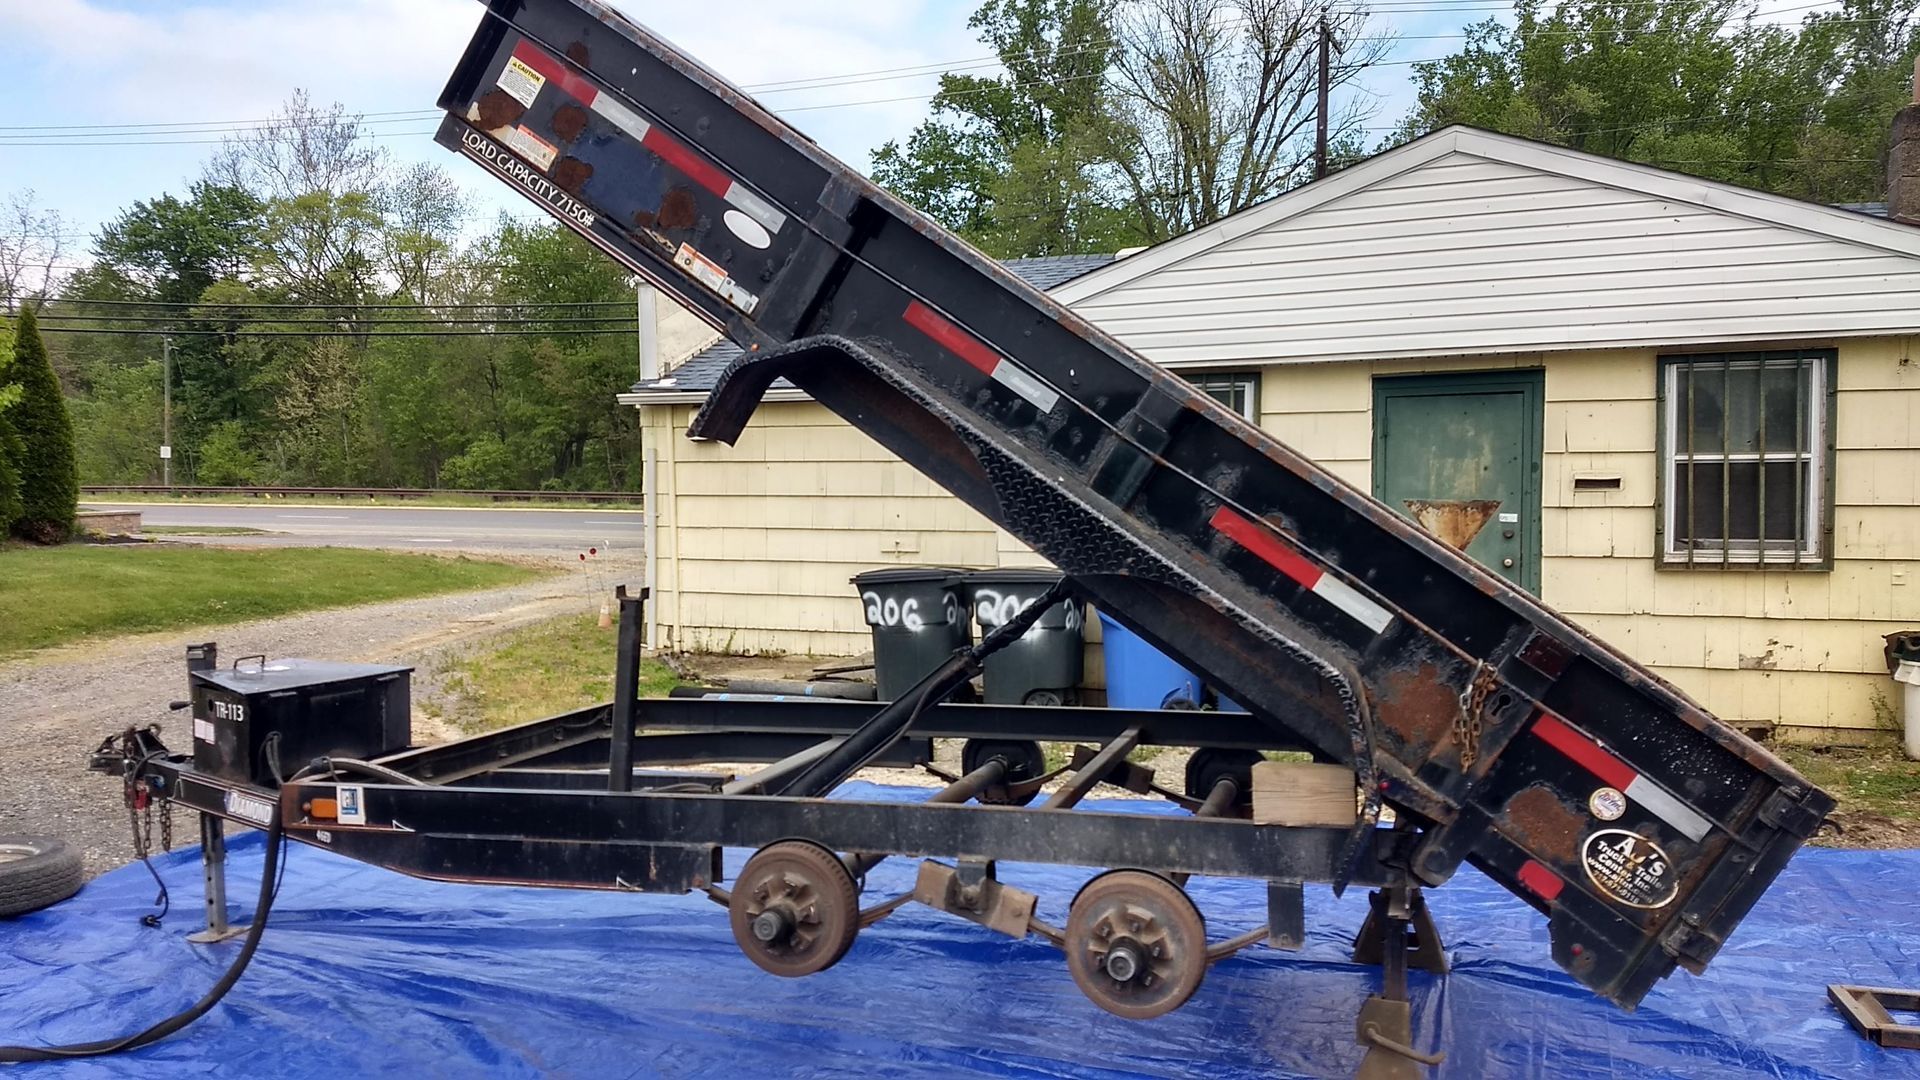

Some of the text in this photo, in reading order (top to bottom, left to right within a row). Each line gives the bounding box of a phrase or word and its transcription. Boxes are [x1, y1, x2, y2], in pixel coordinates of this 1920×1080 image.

[517, 64, 541, 82] CAUTION
[461, 128, 497, 160] LOAD
[496, 154, 558, 202] CAPACITY
[556, 193, 596, 228] 7150#
[863, 591, 926, 632] 206
[214, 701, 244, 722] TR-113
[230, 791, 273, 824] DIAMOND
[1597, 840, 1626, 865] Truck
[1625, 861, 1635, 871] &
[1598, 853, 1652, 895] Center, Inc.
